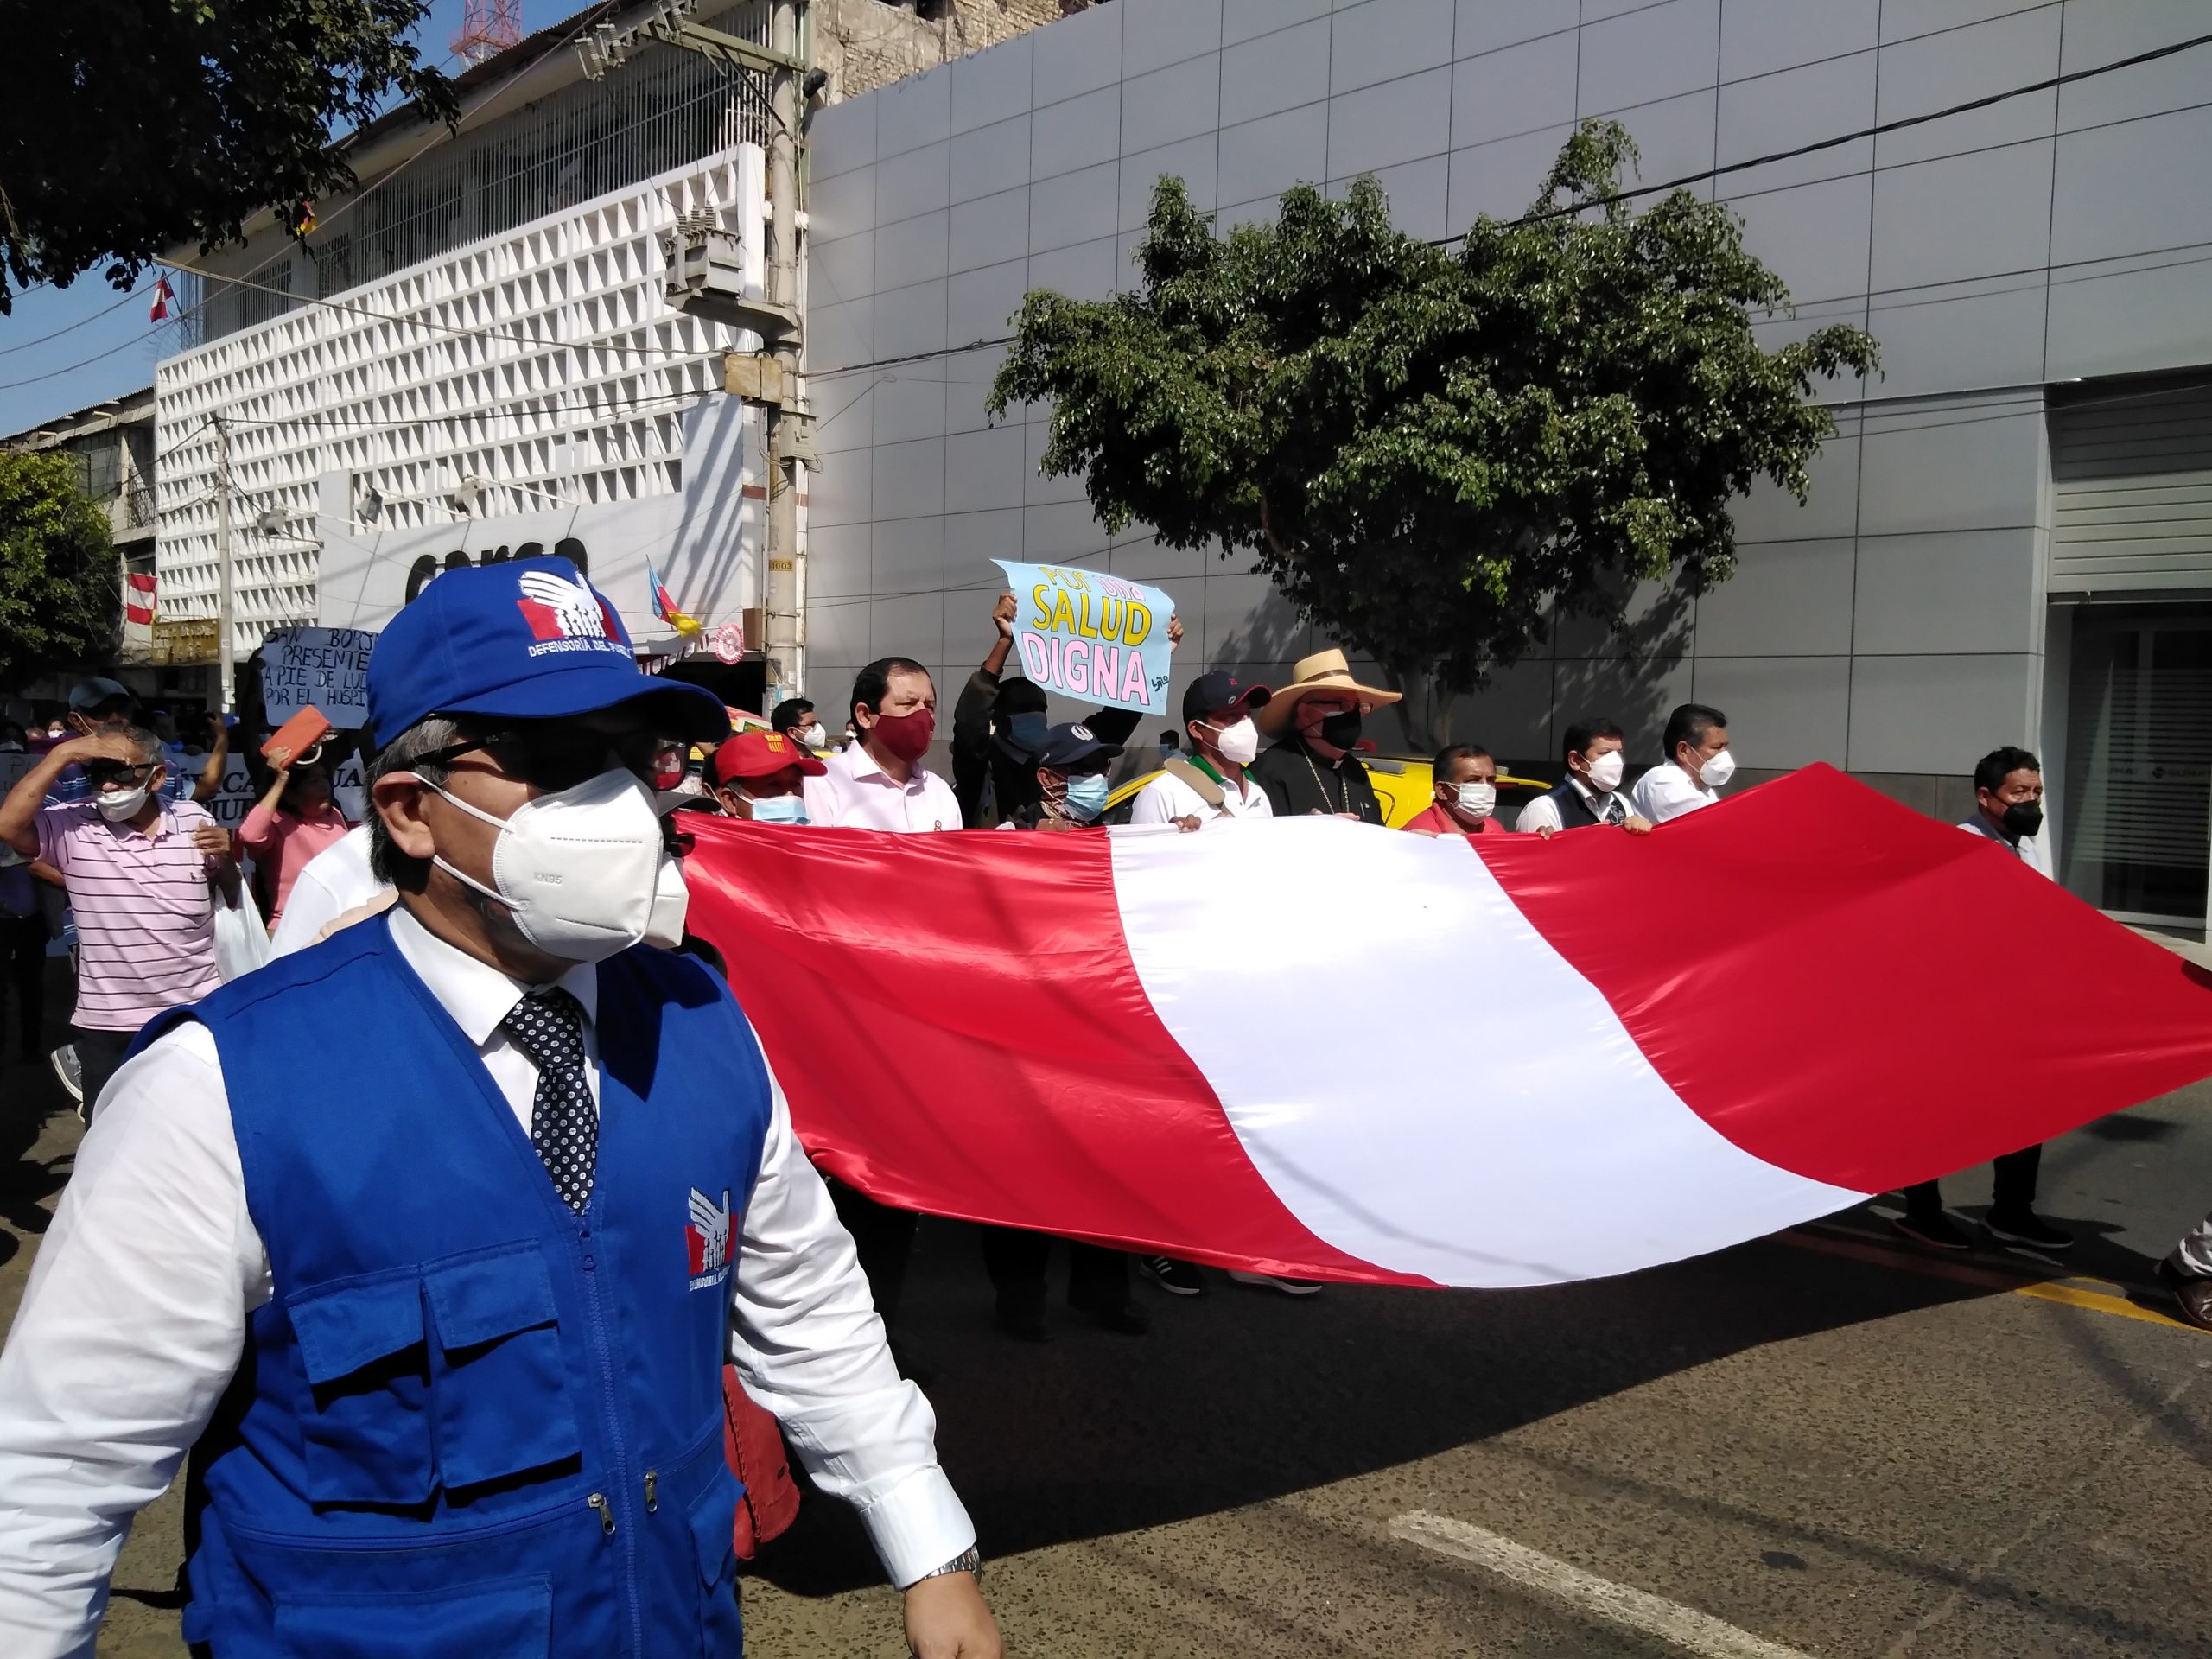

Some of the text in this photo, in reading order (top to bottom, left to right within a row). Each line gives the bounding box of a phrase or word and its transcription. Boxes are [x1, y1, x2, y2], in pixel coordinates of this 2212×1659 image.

[1033, 584, 1152, 646] SALUD
[266, 628, 378, 651] SAN BORJ
[528, 637, 591, 658] DEFENSORÍA
[282, 645, 371, 671] PRESENTE
[1021, 632, 1150, 706] DIGNA
[277, 665, 308, 686] PIE
[315, 670, 335, 688] DE
[266, 688, 290, 706] POR
[296, 689, 316, 705] EL
[534, 872, 563, 885] KN95
